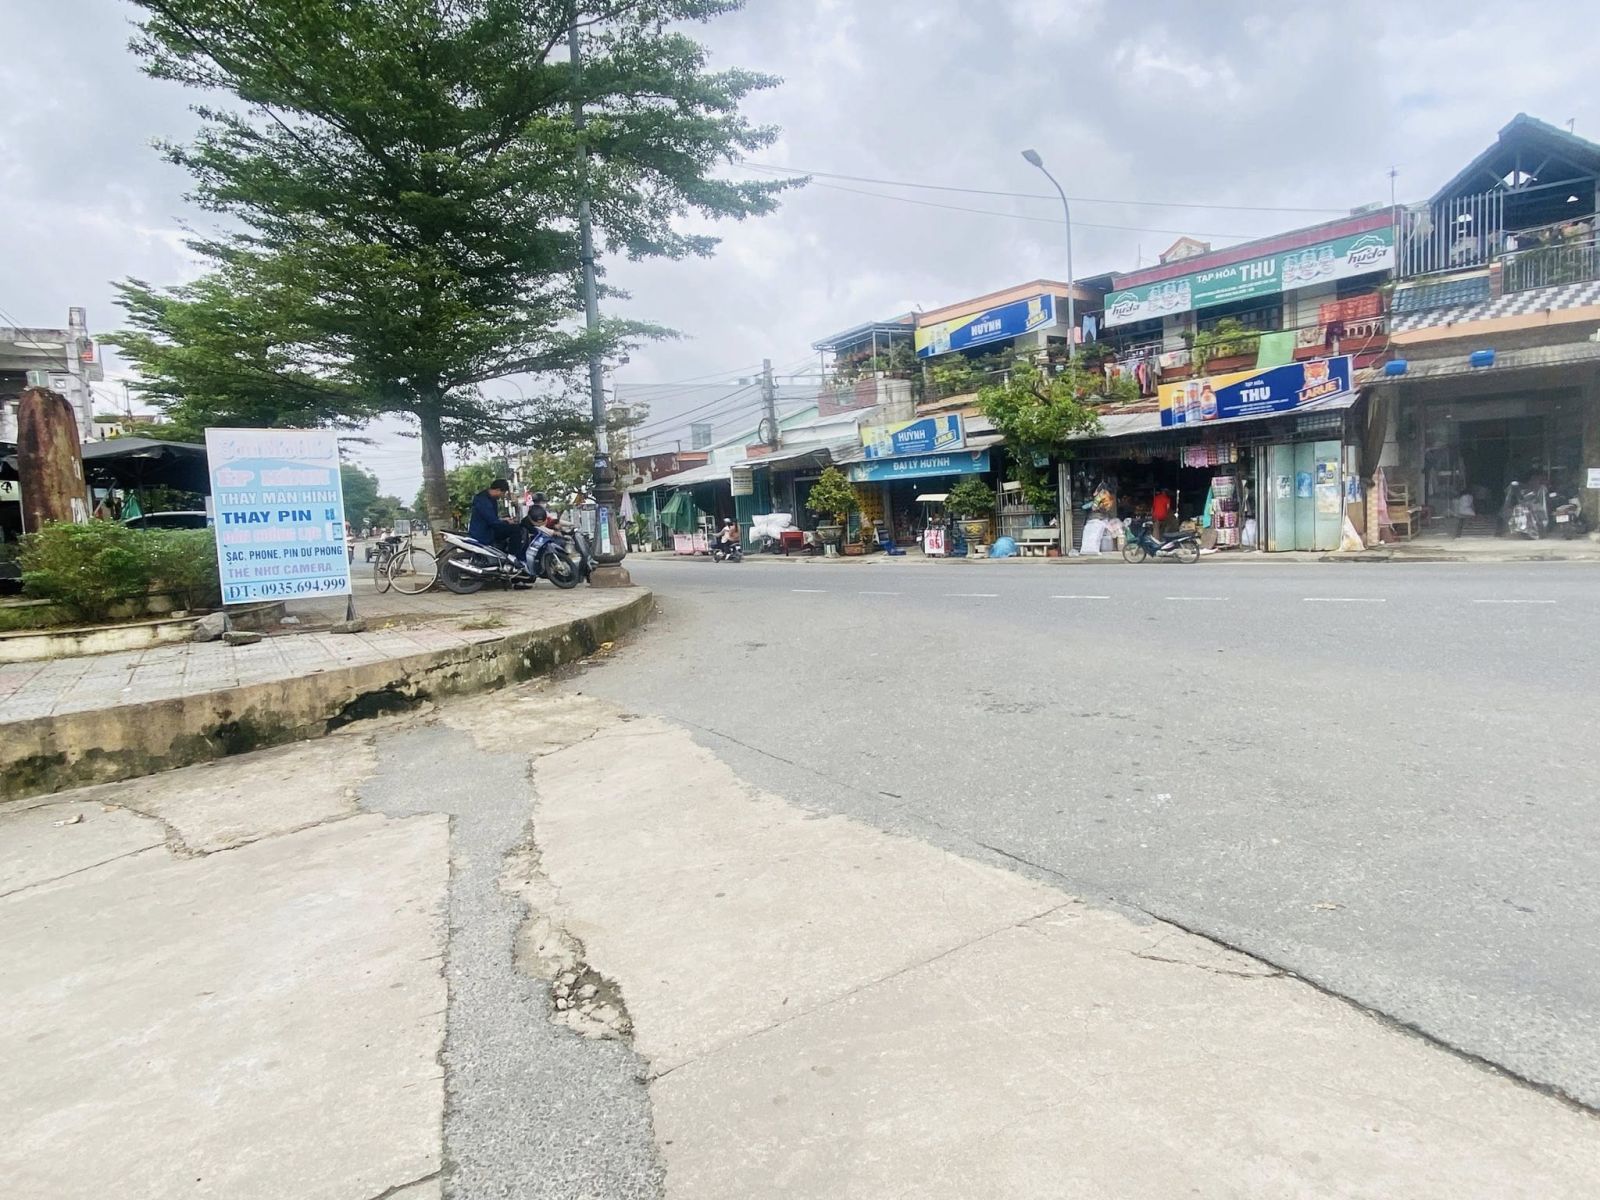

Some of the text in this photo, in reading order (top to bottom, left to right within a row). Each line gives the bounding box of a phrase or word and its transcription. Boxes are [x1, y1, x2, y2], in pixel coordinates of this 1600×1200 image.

[1239, 258, 1275, 282] THU
[1240, 386, 1271, 403] THU
[1299, 381, 1338, 401] LARUE
[220, 492, 257, 505] THAY
[222, 510, 312, 524] THAY PIN
[283, 547, 298, 558] PIN
[284, 562, 333, 575] CAMERA
[261, 578, 346, 596] 0935.694.999
